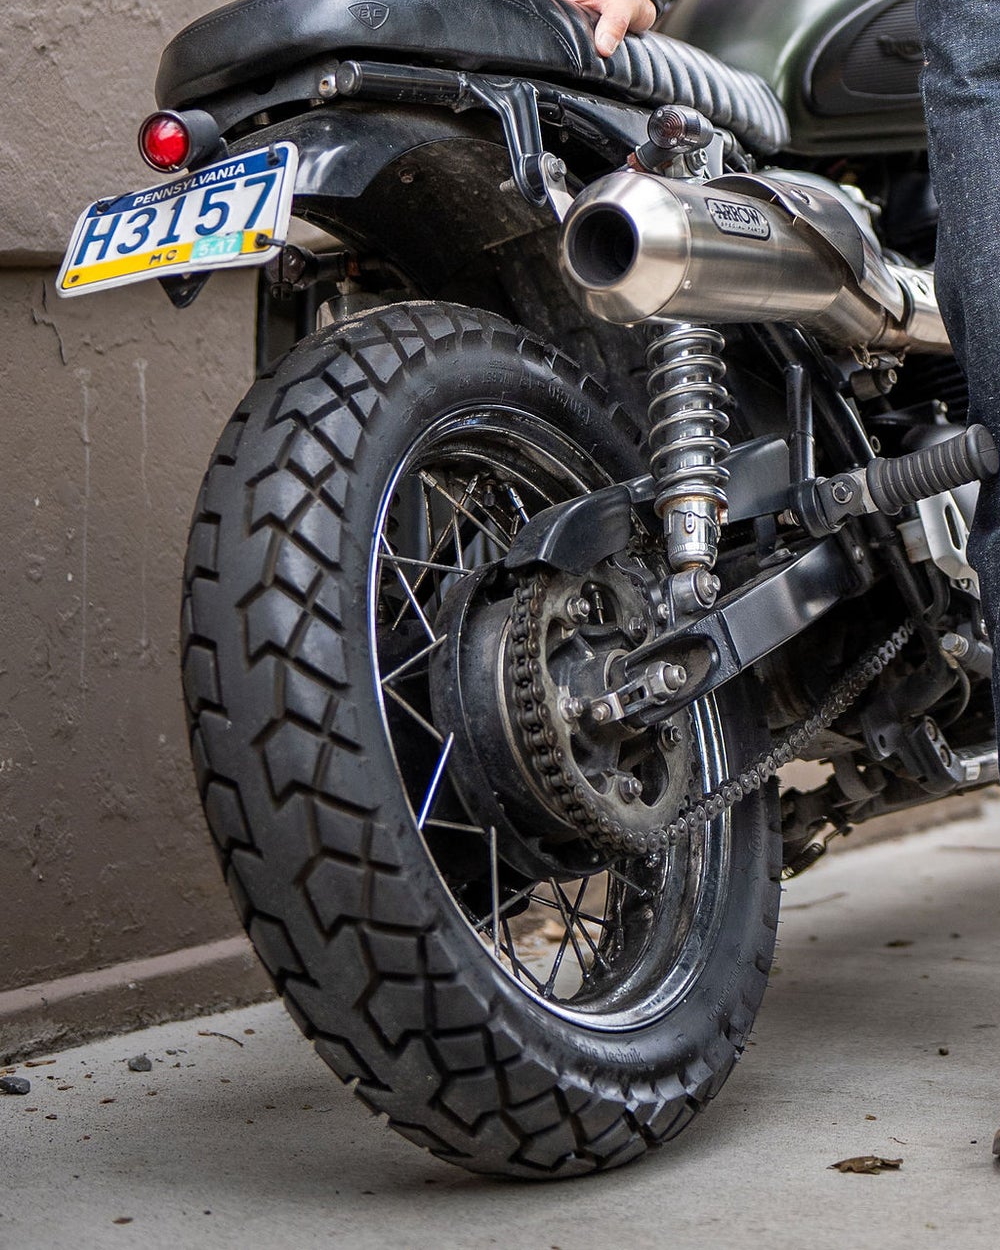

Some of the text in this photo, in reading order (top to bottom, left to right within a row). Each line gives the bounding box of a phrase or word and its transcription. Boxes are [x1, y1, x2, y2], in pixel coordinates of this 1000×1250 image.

[133, 162, 246, 207] PENNSYLVANIA
[74, 172, 277, 266] H3157
[714, 202, 761, 226] ARROW
